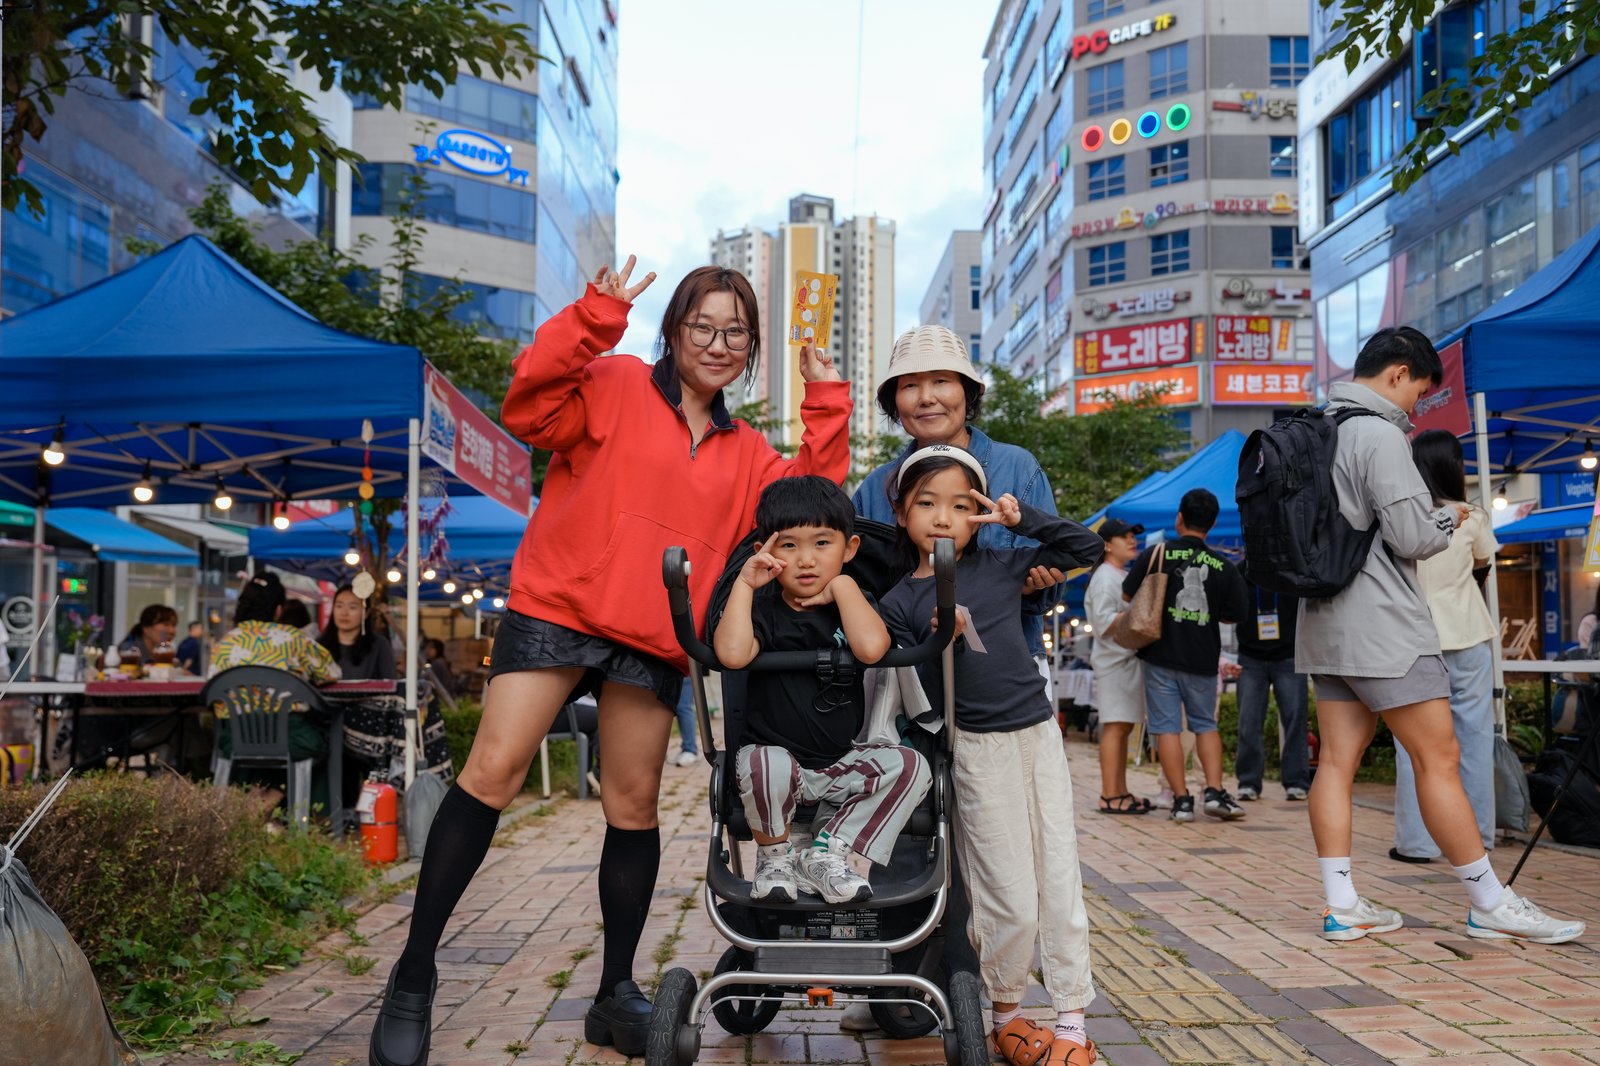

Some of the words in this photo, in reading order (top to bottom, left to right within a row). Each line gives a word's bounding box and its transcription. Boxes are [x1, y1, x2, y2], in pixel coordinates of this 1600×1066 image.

[1072, 29, 1109, 60] PC
[1109, 19, 1152, 44] CAFE
[1155, 12, 1173, 31] 7F
[509, 167, 528, 186] PT
[1118, 288, 1175, 316] 노래방
[1101, 322, 1188, 368] 노래방
[1218, 333, 1270, 360] 노래방
[1226, 374, 1300, 394] 세븐코코
